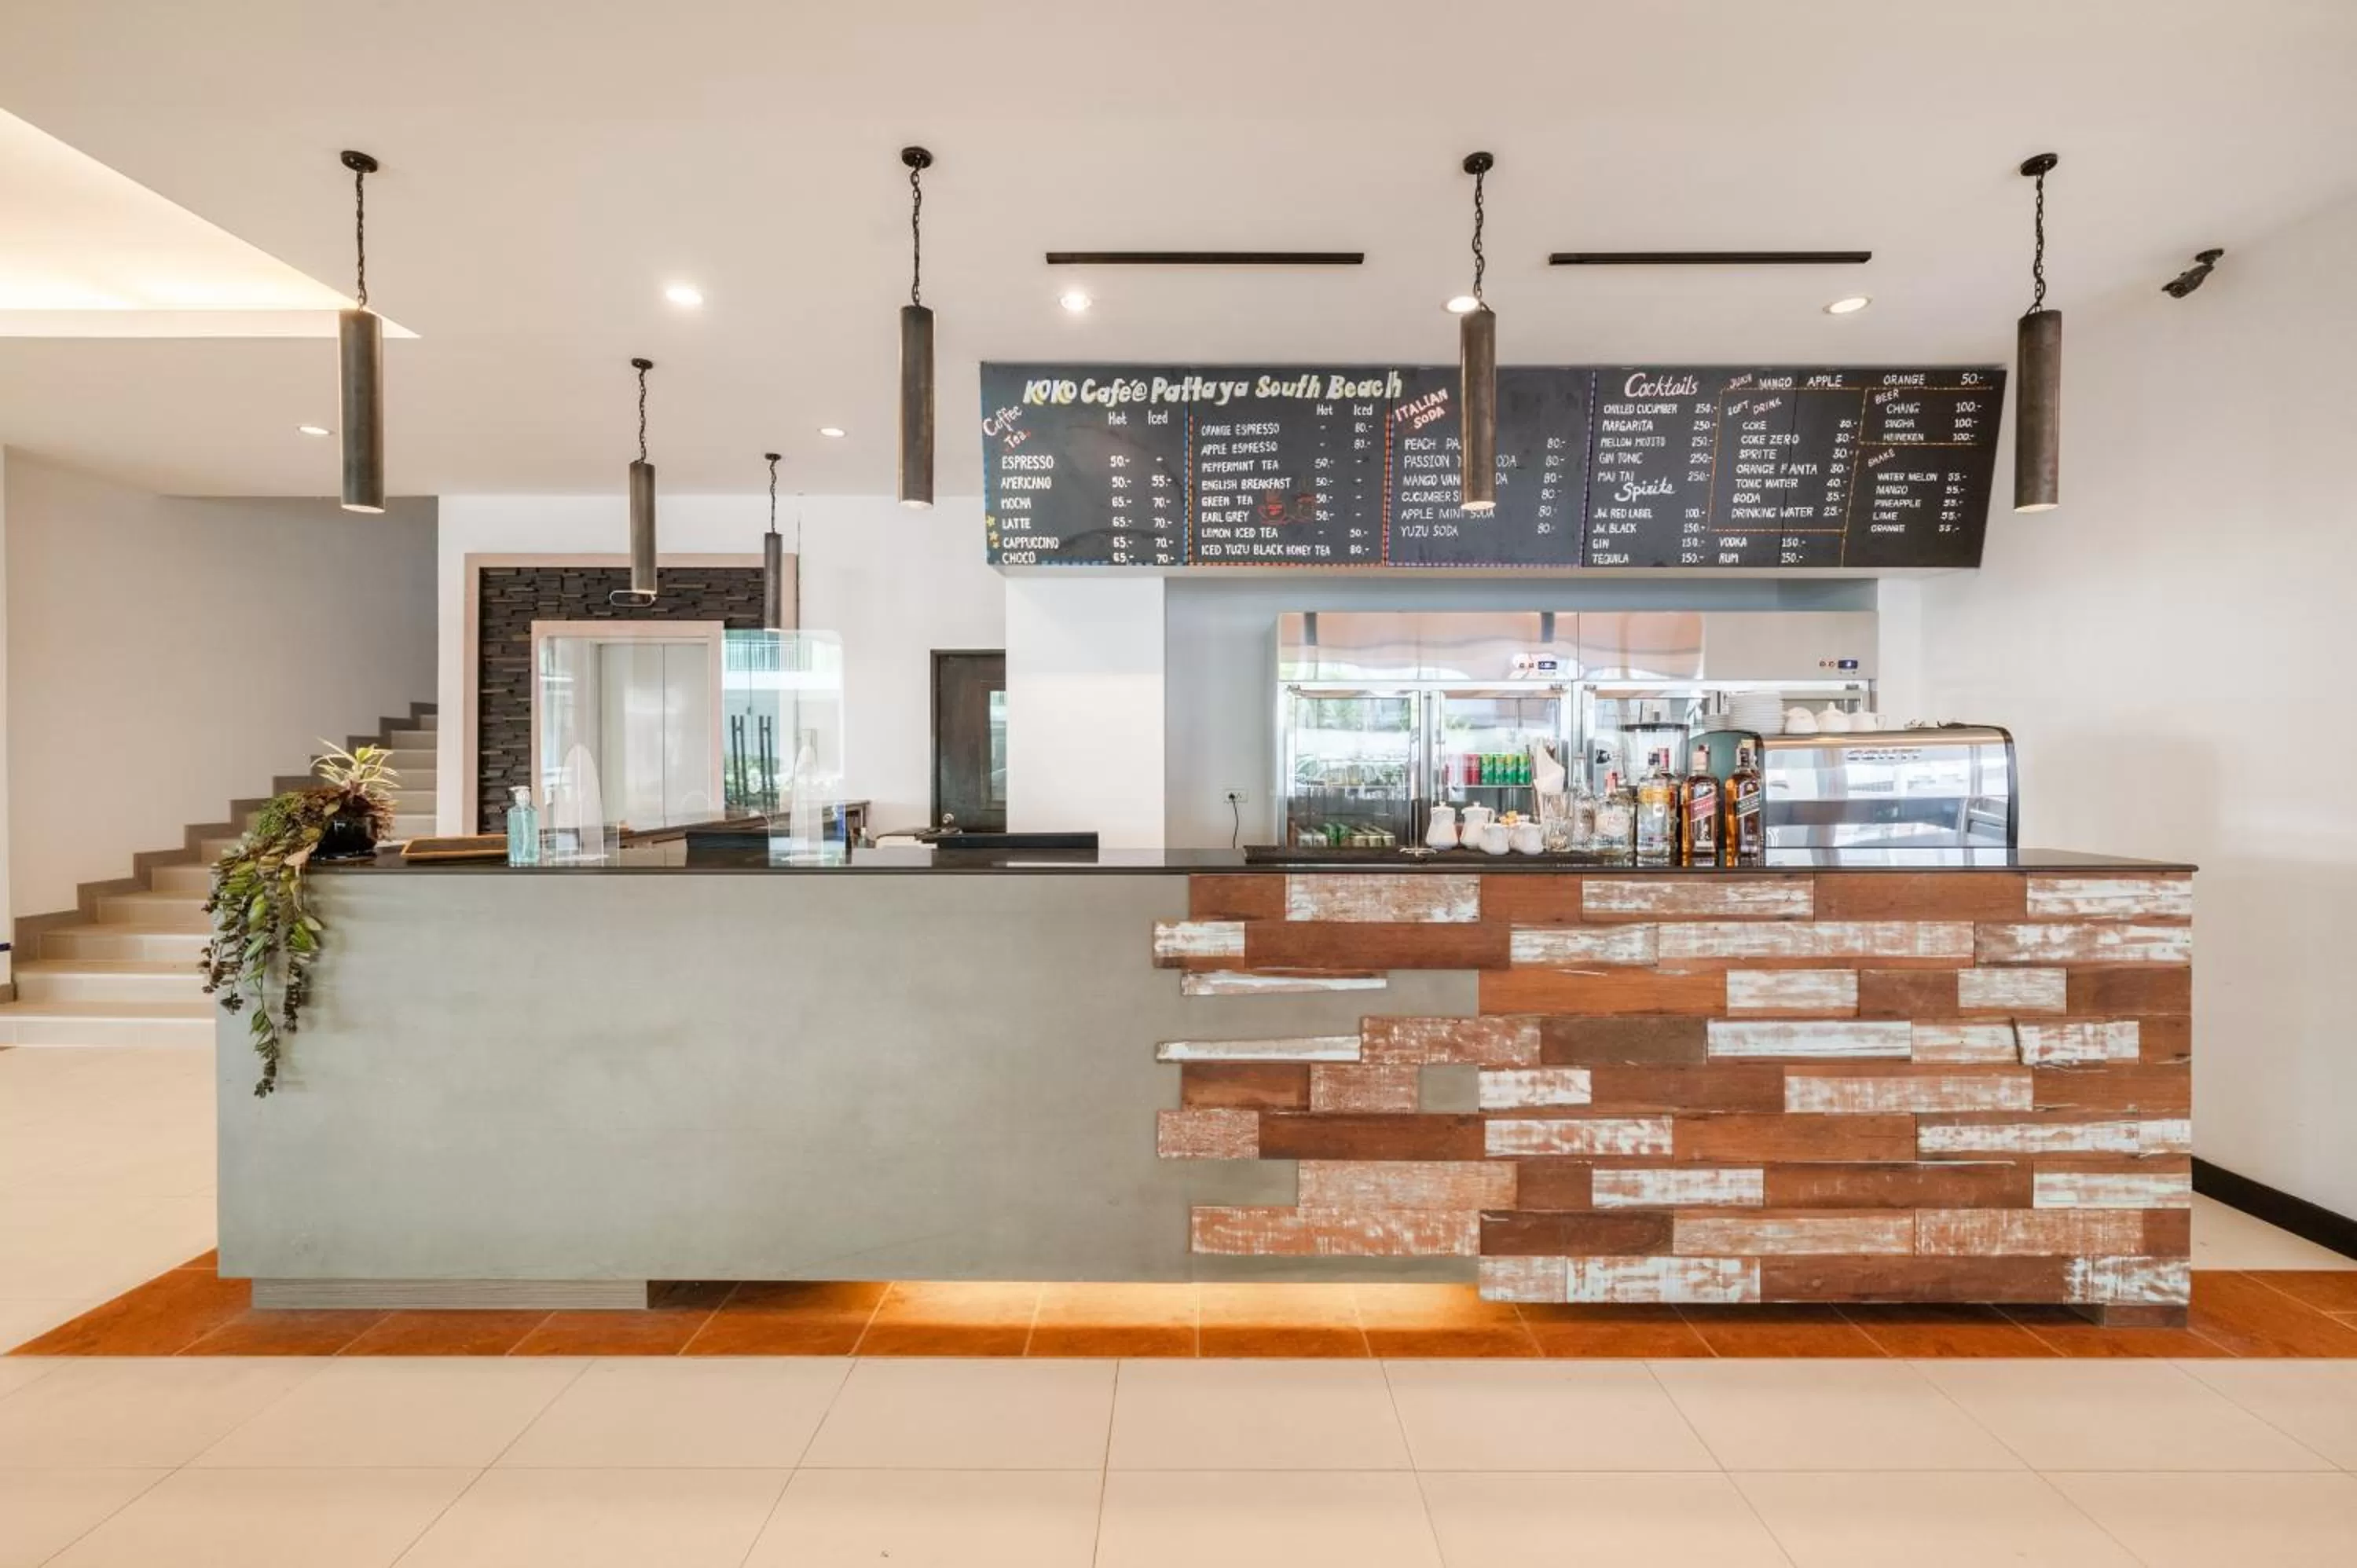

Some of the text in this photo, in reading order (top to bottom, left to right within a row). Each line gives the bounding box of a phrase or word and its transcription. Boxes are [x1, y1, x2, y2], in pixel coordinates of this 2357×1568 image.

[1624, 372, 1699, 397] Cocktails
[1759, 377, 1793, 388] MANGO
[1807, 375, 1842, 387] APPLE
[1883, 374, 1925, 386] ORANGE
[1960, 373, 1984, 386] 50.-
[1022, 379, 1077, 405] KOKO
[1149, 376, 1250, 406] Pattaya
[1255, 374, 1321, 398] South
[1326, 370, 1403, 399] Beach
[1875, 389, 1899, 405] BEER
[1317, 405, 1373, 416] Hot Iced
[1395, 387, 1449, 422] ITALIAN
[1604, 404, 1634, 414] CHILLED
[1637, 404, 1677, 414] CUCUMBER
[1886, 402, 1981, 414] CHANG 100.-
[983, 405, 1022, 436] Coffee
[1108, 410, 1168, 424] Hot Iced
[1413, 407, 1446, 430] SODA
[1201, 425, 1231, 436] ORANGE
[1236, 423, 1280, 435] ESPRESSO
[1603, 419, 1653, 431] MARGARITA
[1743, 420, 1767, 430] COKE
[1885, 419, 1979, 428] SINGHA 100.-
[1003, 432, 1025, 449] Tea
[1600, 438, 1632, 447] MELLOW
[1635, 437, 1666, 447] MOJITO
[1741, 434, 1766, 445] COKE
[1769, 434, 1799, 445] ZERO
[1883, 433, 1924, 441] HEINEKEN
[1200, 444, 1226, 456] APPLE
[1232, 441, 1277, 454] ESPRESSO
[1405, 438, 1436, 451] PEACH
[1599, 452, 1614, 464] GIN
[1618, 452, 1643, 464] TONIC
[1739, 449, 1777, 460] SPRITE
[1002, 456, 1054, 469] ESPRESSO
[1202, 460, 1254, 473] PEPPERMINT
[1262, 460, 1278, 471] TEA
[1404, 455, 1450, 468] PASSION
[1496, 455, 1516, 468] ODA
[1736, 464, 1775, 474] ORANGE
[1780, 463, 1818, 474] FANTA
[1001, 476, 1052, 489] AMERICANO
[1402, 474, 1437, 486] MANGO
[1908, 472, 1938, 482] MELON
[1202, 478, 1237, 491] ENGLISH
[1241, 478, 1292, 490] BREAKFAST
[1615, 476, 1676, 502] Spirits
[1735, 478, 1761, 489] TONIC
[1765, 478, 1798, 489] WATER
[1402, 490, 1450, 502] CUCUMBER
[1876, 485, 1908, 495] MANGO
[1002, 497, 1031, 510] MOCHA
[1201, 496, 1230, 507] GREEN
[1237, 496, 1253, 506] TEA
[1732, 493, 1761, 504] SODA
[1875, 499, 1921, 507] PINEAPPLE
[1201, 512, 1225, 523] EARL
[1226, 511, 1250, 522] GREY
[1402, 507, 1433, 520] APPLE
[1611, 509, 1626, 518] RED
[1629, 509, 1652, 518] LABEL
[1732, 507, 1777, 518] DRINKING
[1780, 507, 1814, 518] WATER
[1002, 518, 1031, 529] LATTE
[1609, 523, 1637, 533] BLACK
[1201, 528, 1230, 539] LEMON
[1235, 528, 1255, 538] ICED
[1260, 528, 1278, 538] TEA
[1401, 526, 1428, 537] YUZU
[1433, 525, 1458, 536] SODA
[1003, 537, 1058, 549] CAPPUCCINO
[1593, 539, 1609, 549] GIN
[1719, 537, 1747, 548] VODKA
[1201, 544, 1221, 555] ICED
[1226, 545, 1250, 555] YUZU
[1253, 544, 1284, 555] BLACK
[1286, 545, 1311, 555] HONEY
[1315, 546, 1330, 556] TEA
[1002, 551, 1036, 564] CHOCO
[1593, 554, 1629, 564] TEQUILA
[1719, 553, 1739, 564] RUM
